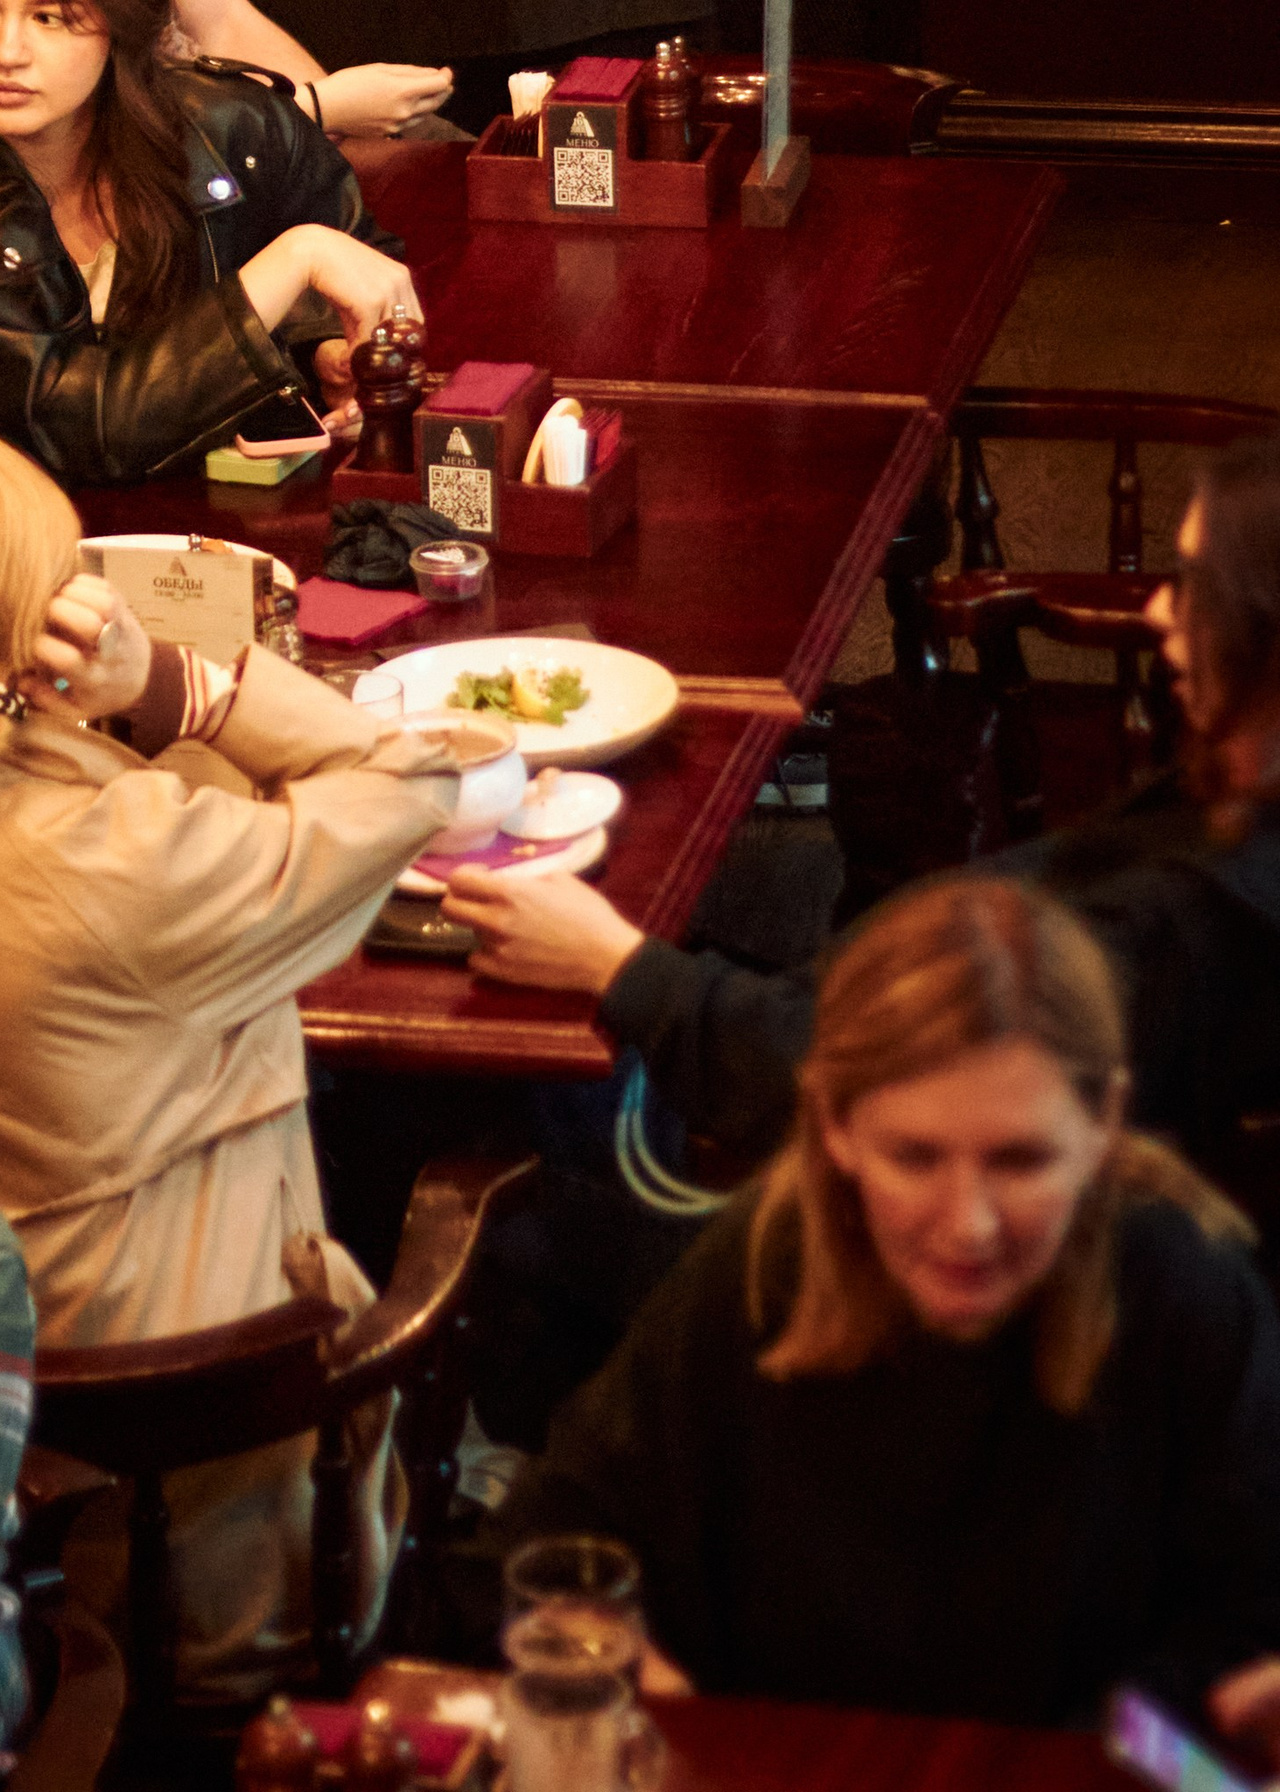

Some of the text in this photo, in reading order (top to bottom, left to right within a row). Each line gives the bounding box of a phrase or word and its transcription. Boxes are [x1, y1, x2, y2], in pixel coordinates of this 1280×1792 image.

[566, 138, 599, 148] МЕНЮ
[441, 455, 477, 467] МЕНЮ
[153, 576, 203, 590] ОБЕДЫ
